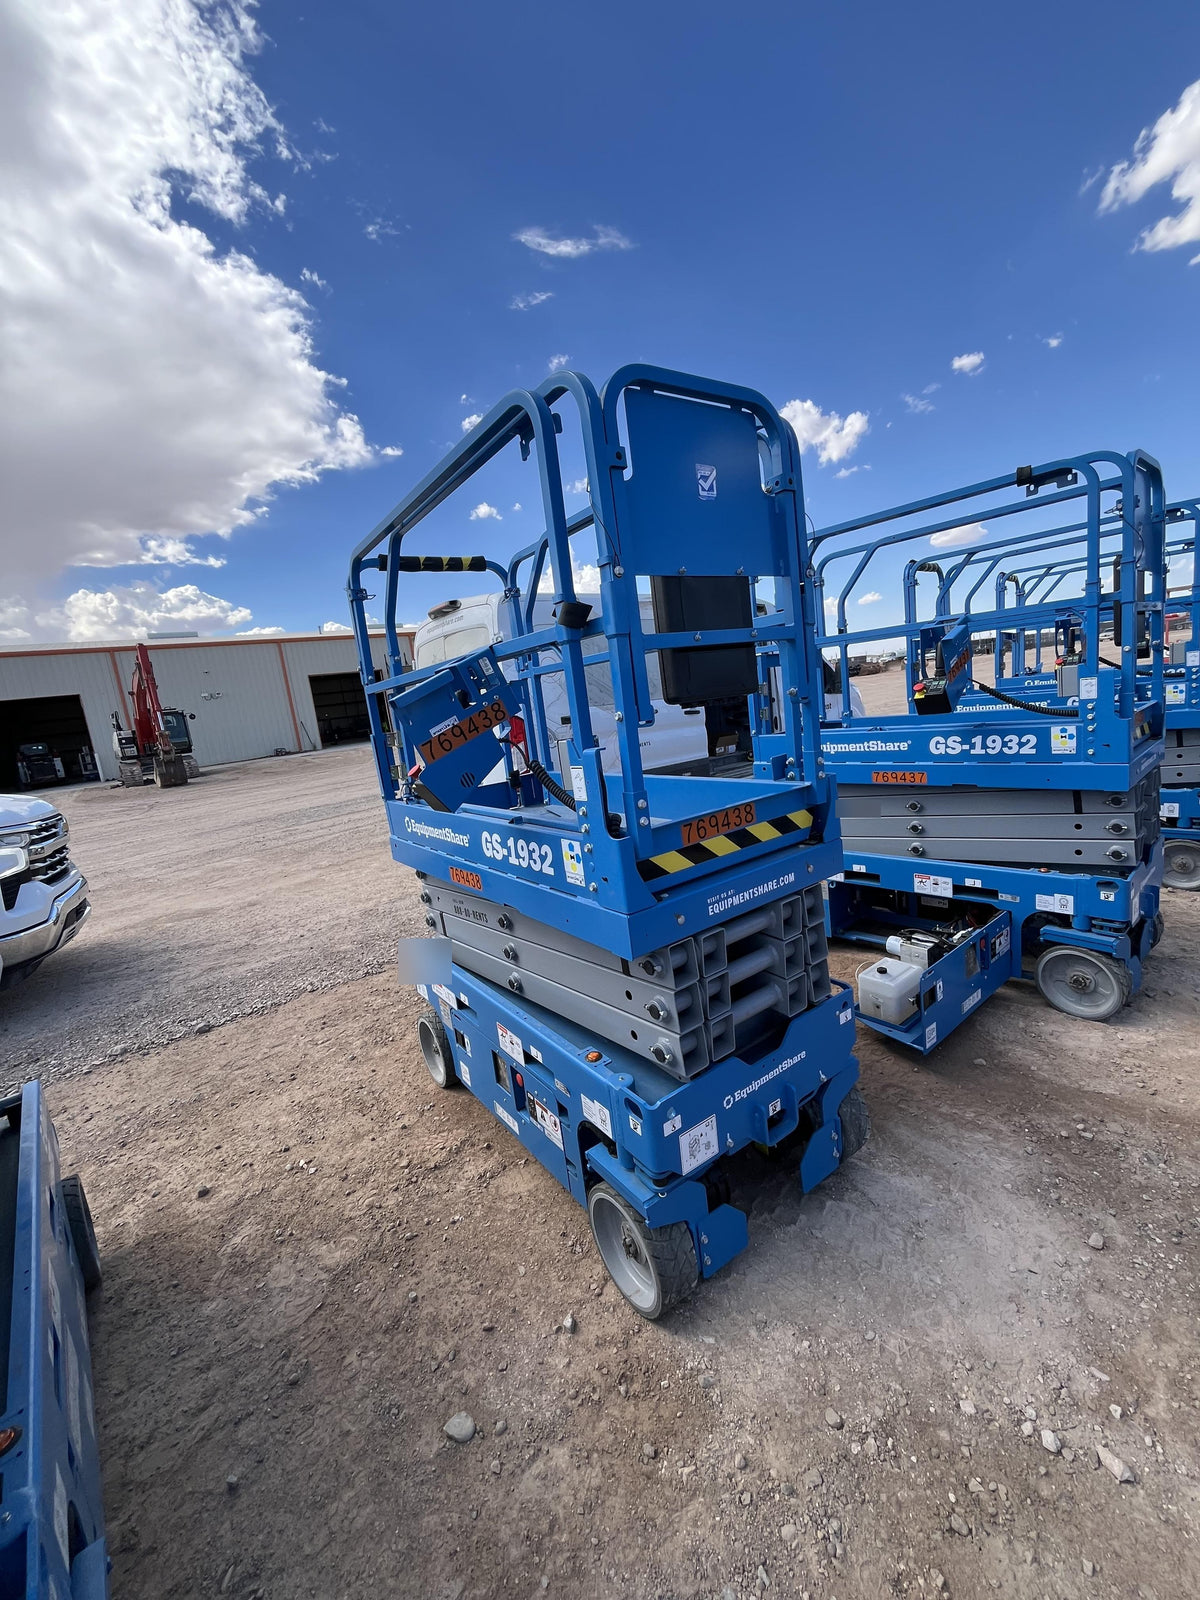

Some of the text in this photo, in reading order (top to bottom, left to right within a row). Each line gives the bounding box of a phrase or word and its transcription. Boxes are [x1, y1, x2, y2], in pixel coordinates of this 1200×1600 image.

[421, 702, 506, 760] 769438
[821, 741, 909, 754] uipmentShare
[929, 734, 1037, 755] GS-1932
[873, 771, 926, 783] 769437
[411, 818, 470, 847] EquipmentShare
[683, 803, 754, 844] 769438
[481, 831, 555, 876] GS-1932
[450, 866, 482, 890] 769438
[708, 872, 795, 916] EQUIPMENTSHARE.COM
[734, 1050, 806, 1102] EquipmentShare
